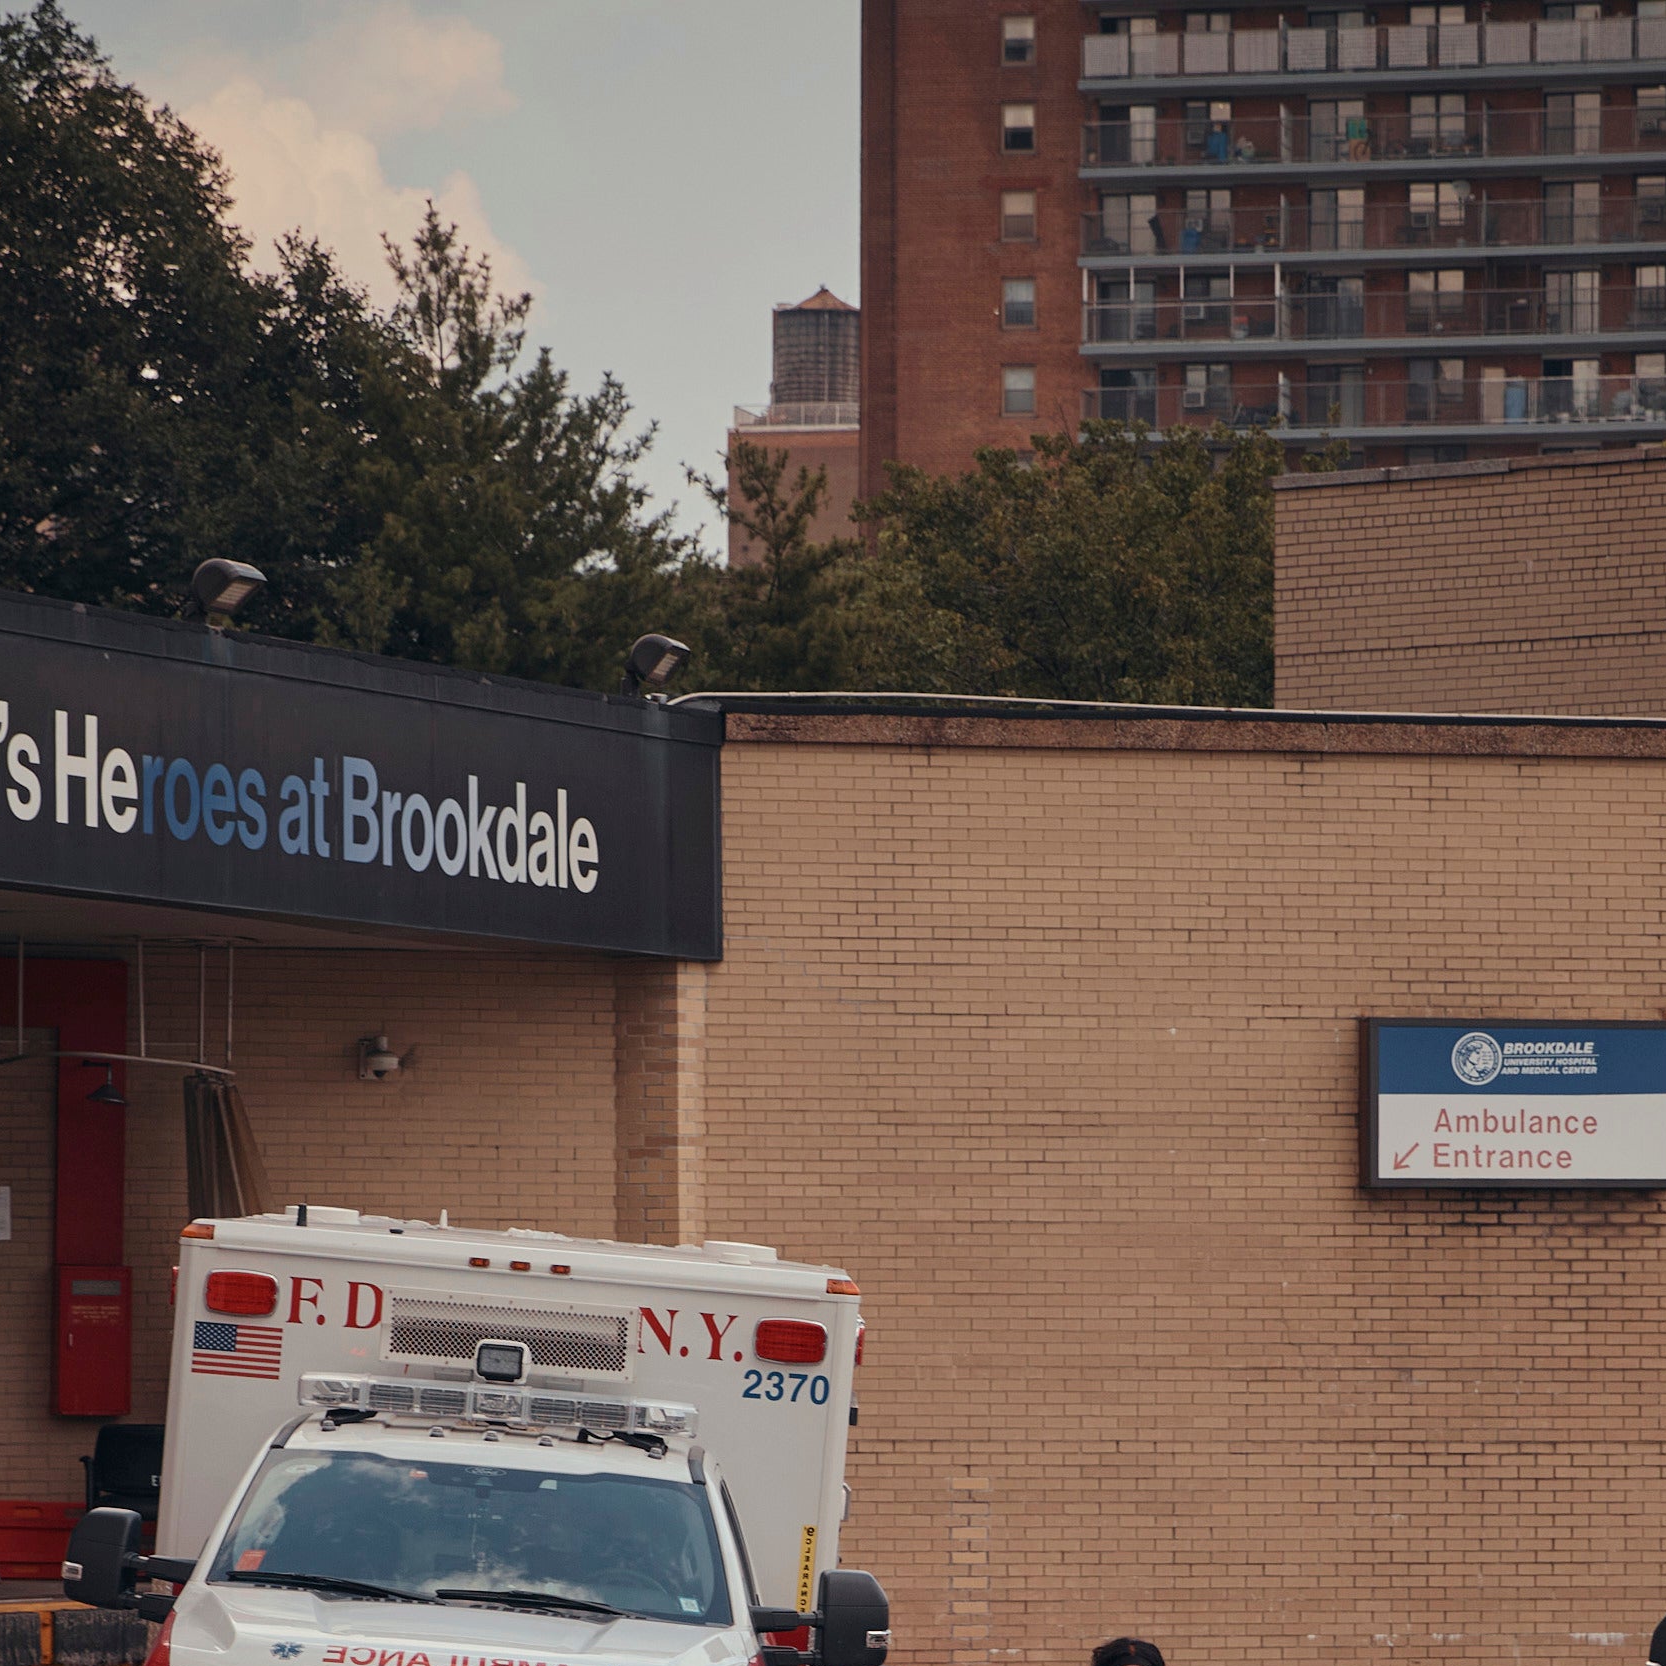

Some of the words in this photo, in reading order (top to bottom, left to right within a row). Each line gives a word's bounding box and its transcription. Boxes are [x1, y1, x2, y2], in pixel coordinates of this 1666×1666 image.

[55, 709, 268, 850] Heroes
[278, 757, 330, 859] at
[342, 756, 599, 893] Brookdale
[1503, 1041, 1595, 1055] BROOKDALE
[1501, 1067, 1520, 1075] AND
[1521, 1067, 1560, 1075] MEDICAL
[1562, 1066, 1598, 1075] CENTER
[1503, 1058, 1554, 1066] UNIVERSITY
[1555, 1058, 1597, 1066] HOSPITAL
[1433, 1108, 1598, 1134] Ambulance
[1433, 1143, 1573, 1169] Entrance
[743, 1369, 830, 1405] 2370
